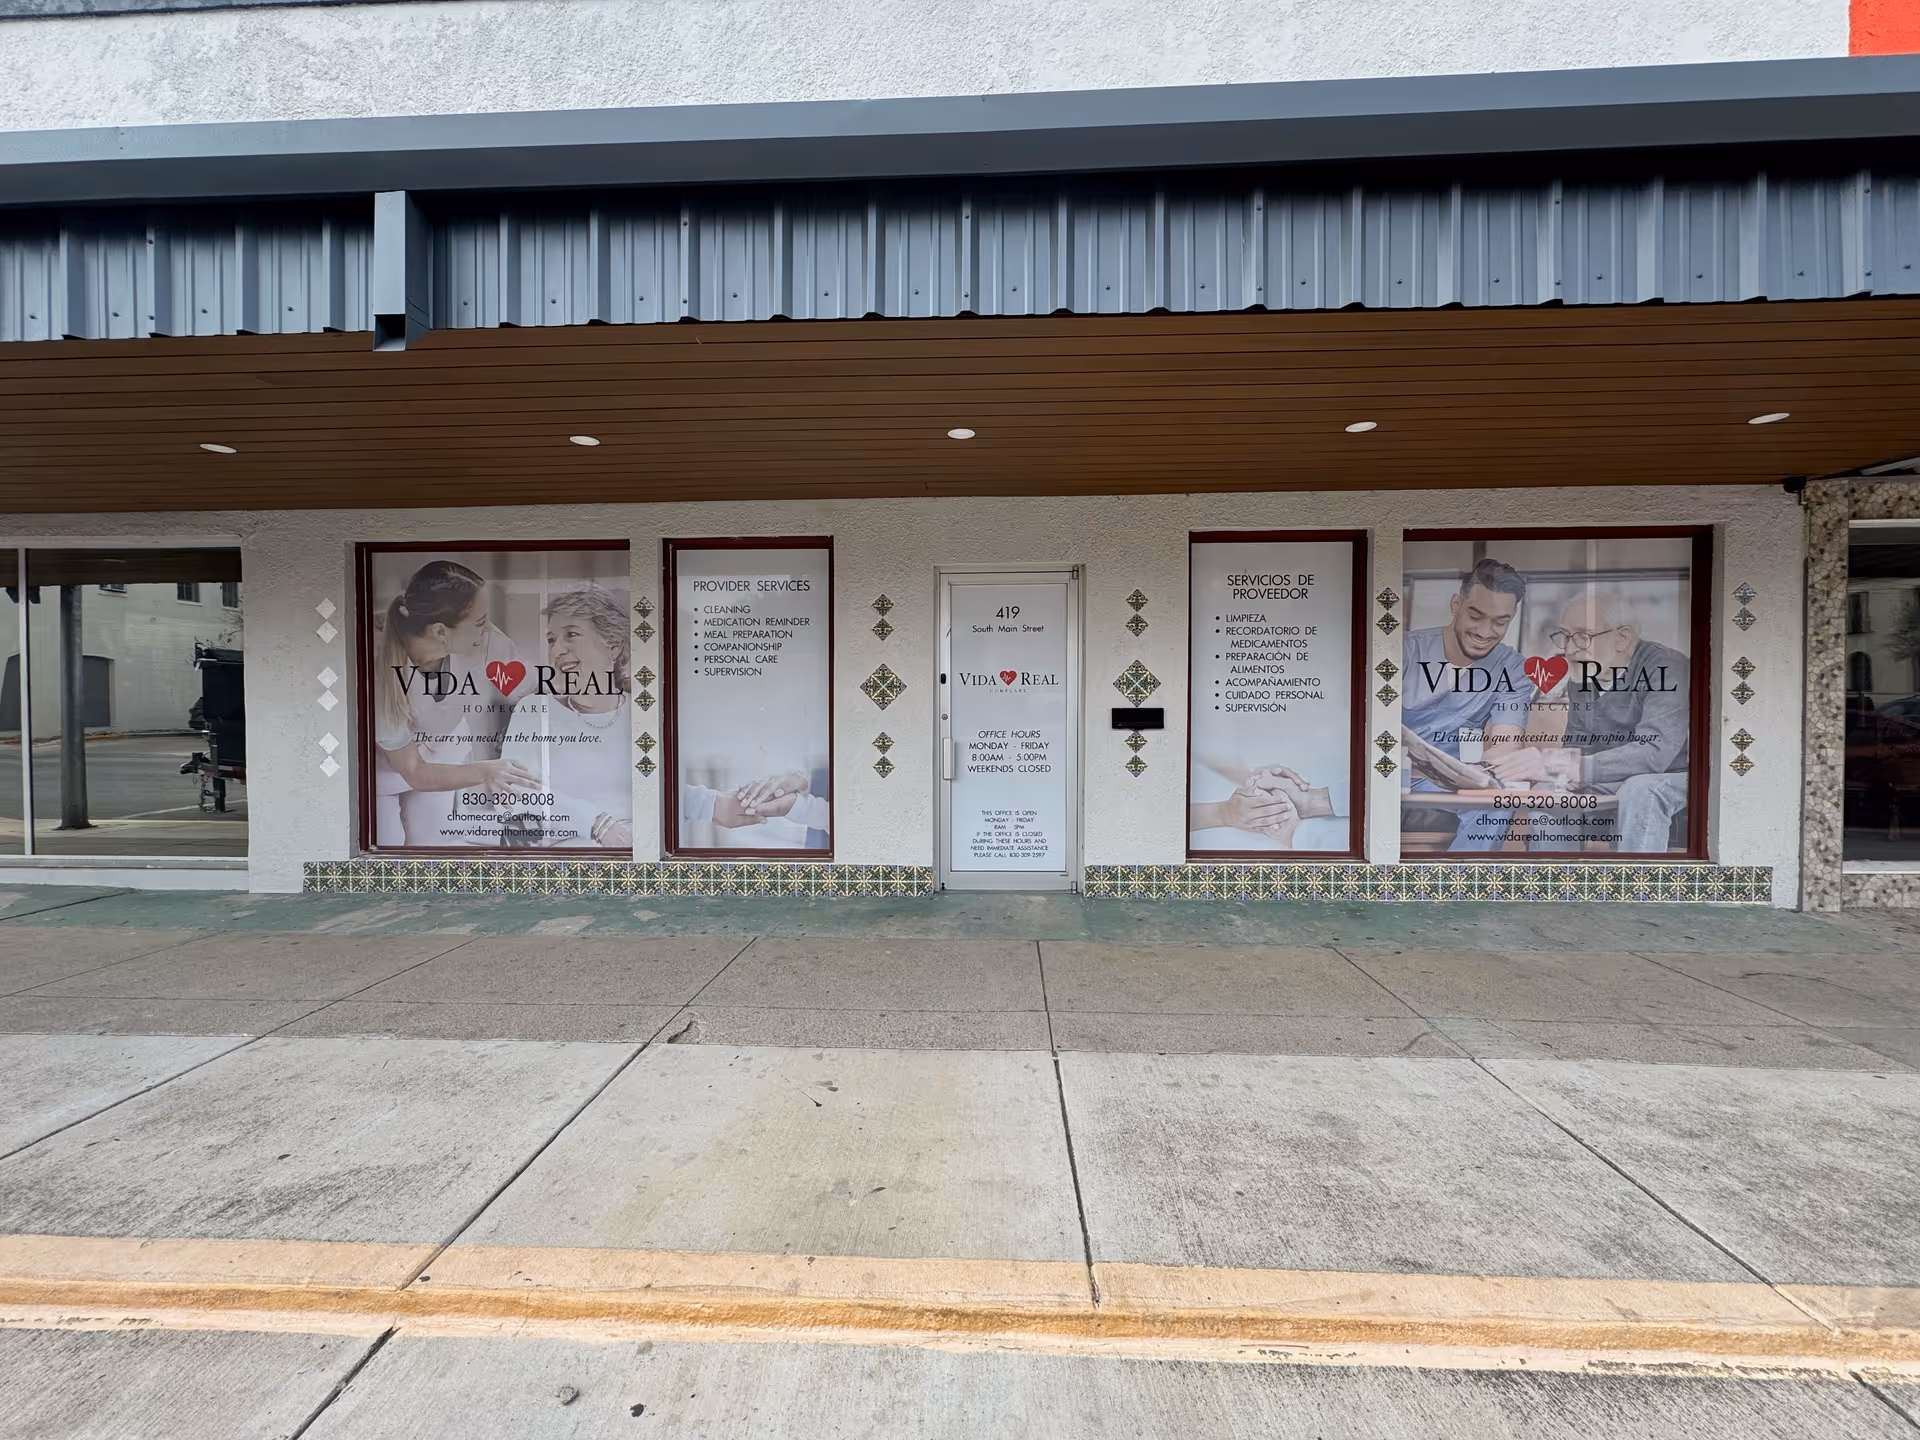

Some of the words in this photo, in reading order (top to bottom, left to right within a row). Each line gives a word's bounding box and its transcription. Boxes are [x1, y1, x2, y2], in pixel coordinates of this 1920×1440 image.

[1227, 574, 1290, 586] SERVICIOS
[1298, 574, 1314, 585] DE
[694, 581, 750, 591] PROVIDER
[757, 580, 810, 591] SERVICES
[1233, 588, 1308, 600] PROVEEDOR
[704, 605, 751, 614] CLEANING
[996, 606, 1020, 619] 419
[704, 618, 760, 626] MEDICATION
[765, 618, 810, 626] REMINDER
[1226, 614, 1266, 622] LIMPIEZA
[972, 624, 993, 633] South
[1226, 626, 1300, 636] RECORDATORIO
[1305, 626, 1317, 635] DE
[704, 630, 727, 638] MEAL
[733, 630, 793, 638] PREPARATION
[704, 643, 782, 651] COMPANIONSHIP
[1230, 640, 1308, 648] MEDICAMENTOS
[704, 655, 750, 663] PERSONAL
[755, 655, 778, 663] CARE
[1226, 651, 1291, 661] PREPARACIÓN
[1296, 652, 1308, 660] DE
[704, 667, 762, 676] SUPERVISION
[1230, 665, 1284, 674] ALIMENTOS
[391, 665, 480, 696] VIDA
[534, 665, 624, 696] REAL
[959, 673, 997, 686] VIDA
[1020, 672, 1059, 685] REAL
[1225, 676, 1320, 686] ACOMPAÑAMIENTO
[1417, 661, 1516, 693] VIDA
[1577, 661, 1677, 692] REAL
[1225, 691, 1270, 699] CUIDADO
[1276, 691, 1324, 699] PERSONAL
[463, 705, 548, 713] HOMECARE
[1226, 702, 1286, 712] SUPERVISIÓN
[1497, 703, 1592, 711] HOMECARE
[414, 732, 433, 743] The
[435, 734, 454, 743] care
[456, 734, 474, 745] you
[476, 732, 500, 743] need,
[502, 732, 513, 743] in
[515, 732, 530, 743] the
[532, 732, 557, 743] home
[559, 734, 576, 745] you
[578, 732, 601, 743] love.
[978, 730, 1007, 738] OFFICE
[1011, 730, 1040, 738] HOURS
[1433, 732, 1446, 742] El
[1447, 731, 1489, 742] cuidado
[1491, 734, 1511, 745] que
[1513, 732, 1559, 742] necesitas
[1561, 734, 1573, 742] en
[1575, 733, 1588, 742] tu
[1589, 732, 1625, 745] propio
[1627, 731, 1661, 745] hogar.
[969, 742, 1008, 750] MONDAY
[462, 793, 554, 806] 830-320-8008
[1493, 796, 1598, 809] 830-320-8008
[447, 811, 570, 823] clhomecare@outlook.com
[1476, 815, 1615, 827] clhomecare@outlook.com
[440, 826, 578, 837] www.vidarealhomecare.com
[1468, 832, 1622, 843] www.vidarealhomecare.com
